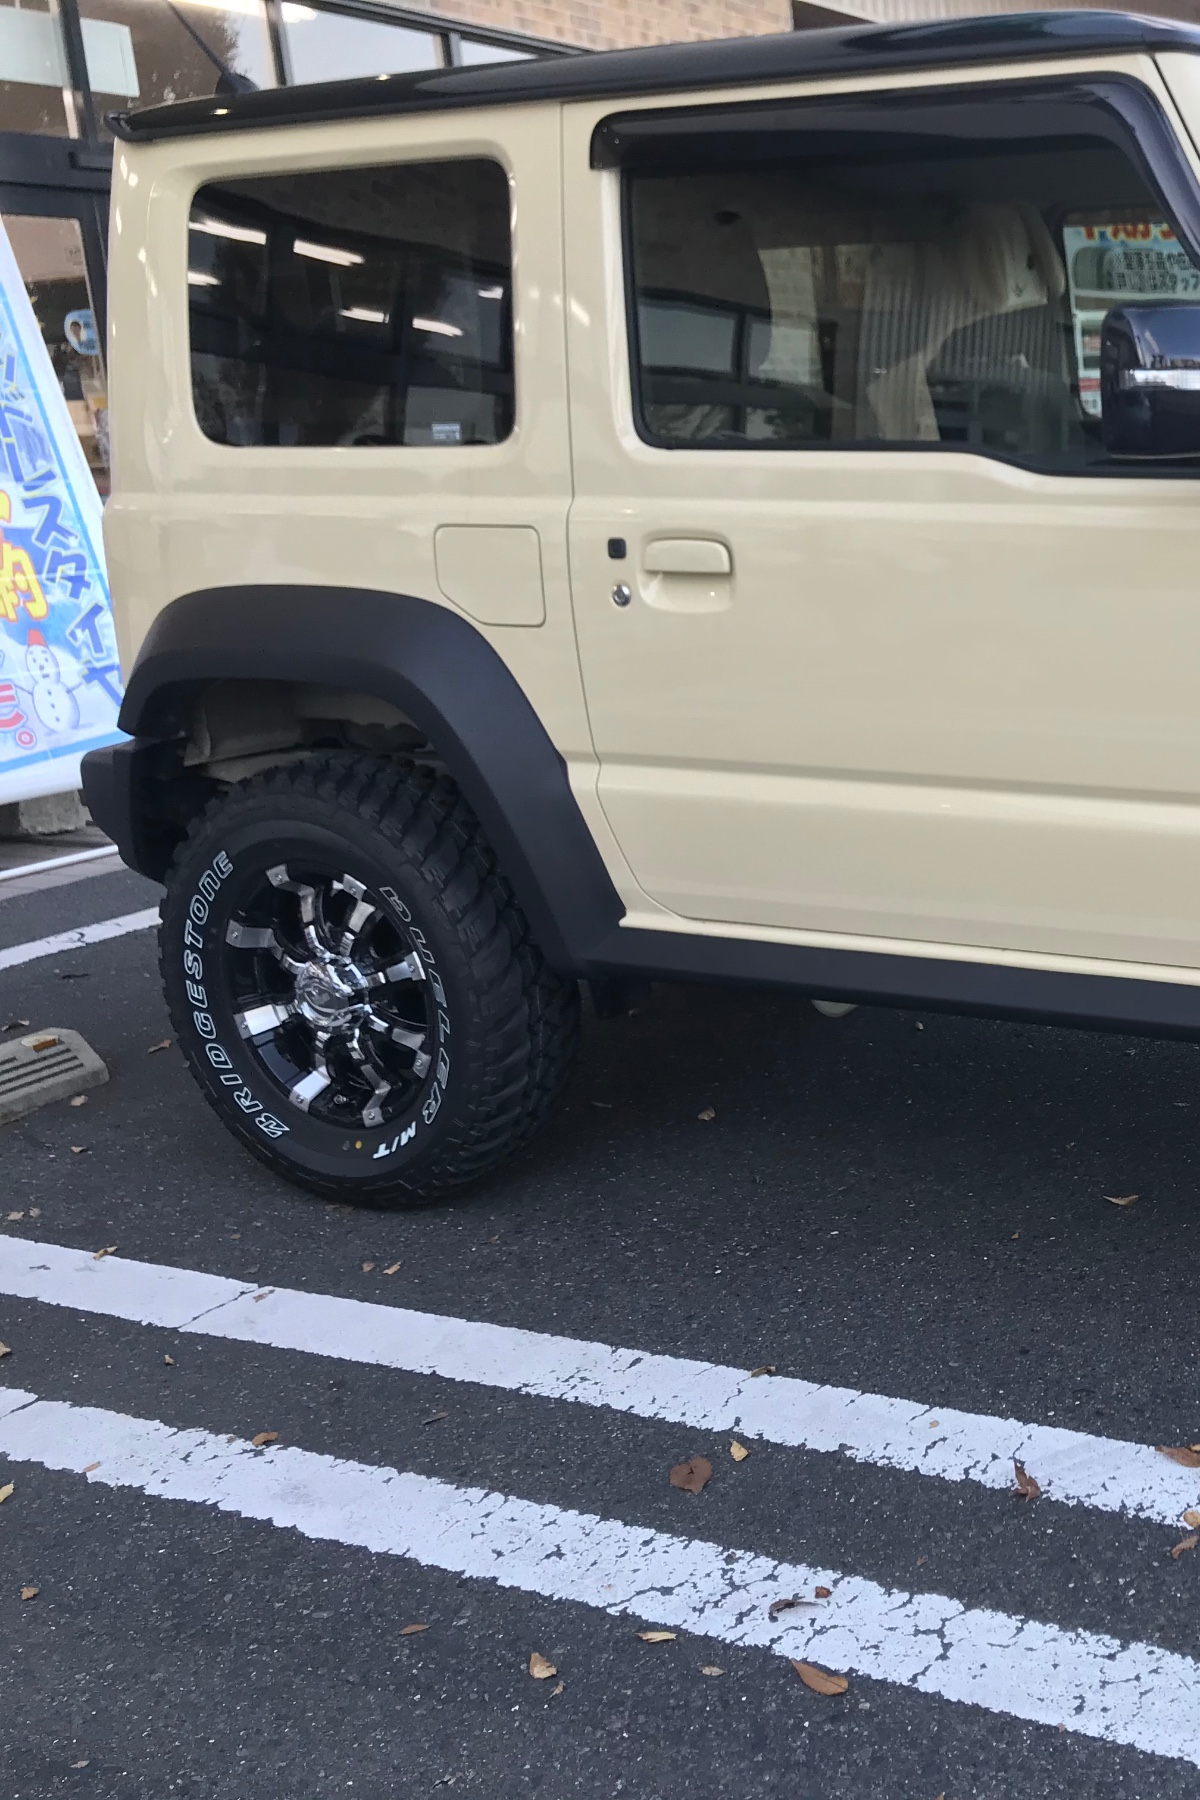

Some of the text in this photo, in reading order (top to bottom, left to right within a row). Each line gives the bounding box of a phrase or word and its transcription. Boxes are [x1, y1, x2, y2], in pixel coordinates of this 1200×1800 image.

[184, 851, 291, 1139] BRIDGESTONE
[372, 886, 451, 1160] DUELER M/T
